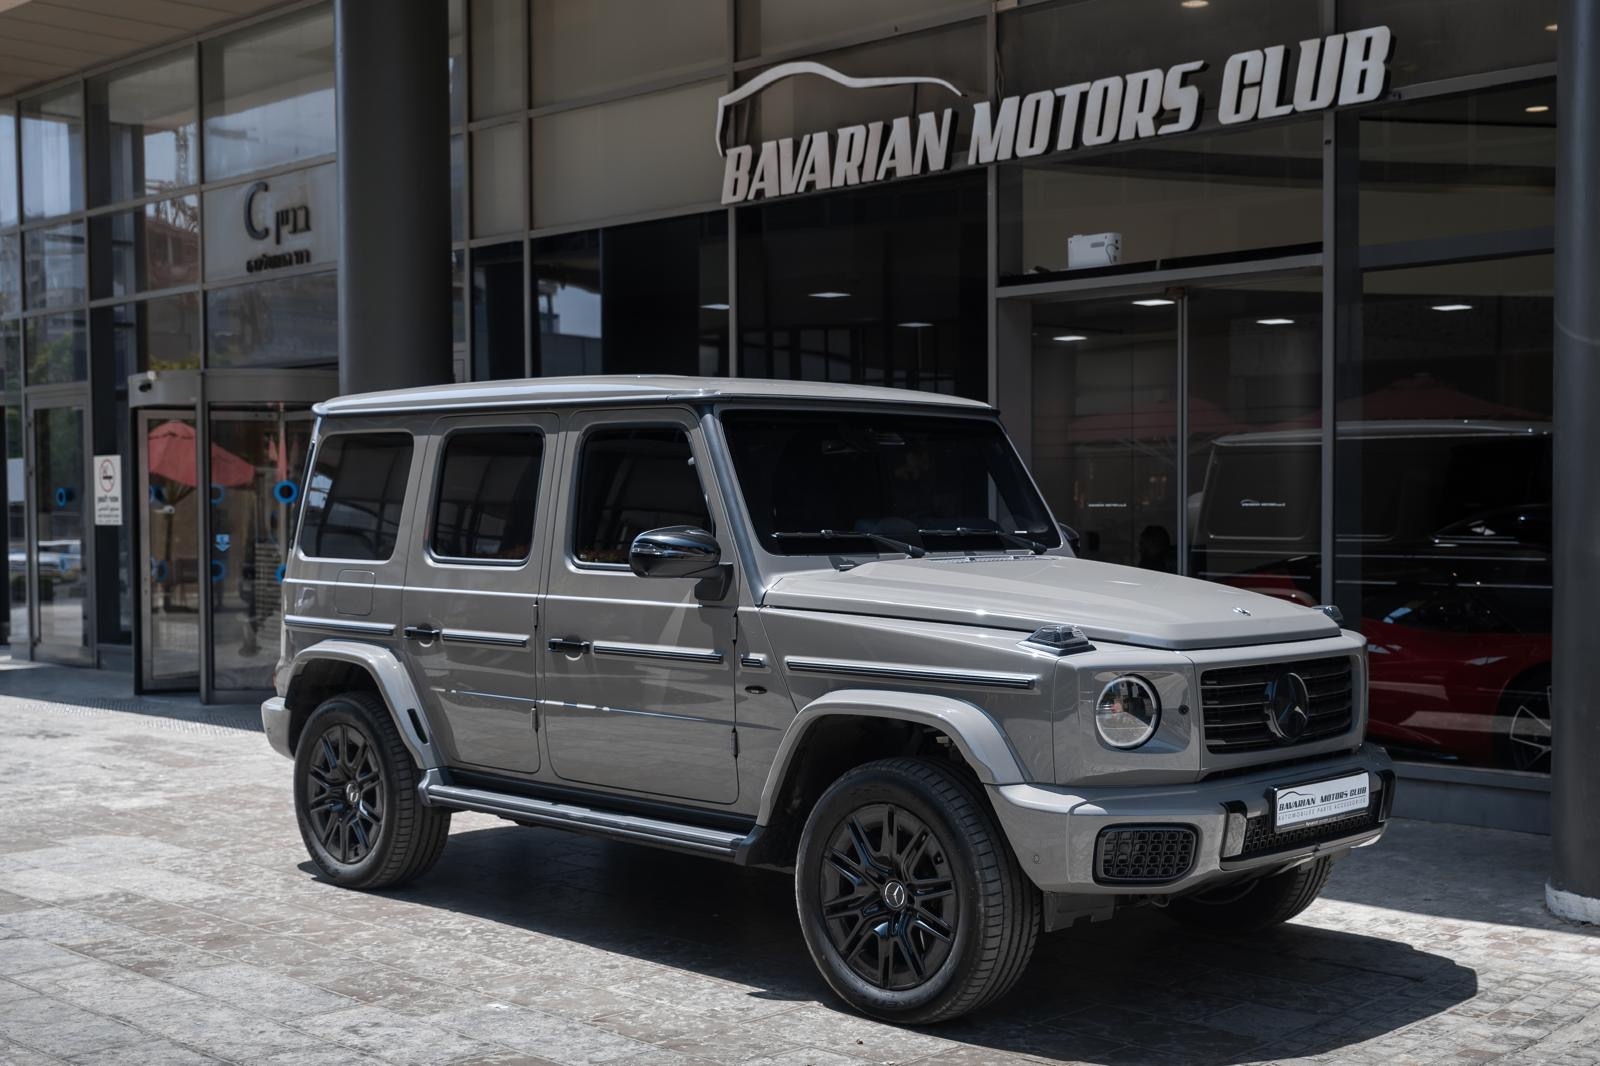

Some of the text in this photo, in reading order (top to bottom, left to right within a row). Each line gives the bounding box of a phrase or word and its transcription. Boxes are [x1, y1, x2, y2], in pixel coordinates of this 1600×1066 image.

[721, 25, 1393, 204] BAVARIAN MOTORS CLUB
[244, 181, 311, 245] בניין C
[1279, 786, 1367, 811] BAVARIAN MOTORS CLUB
